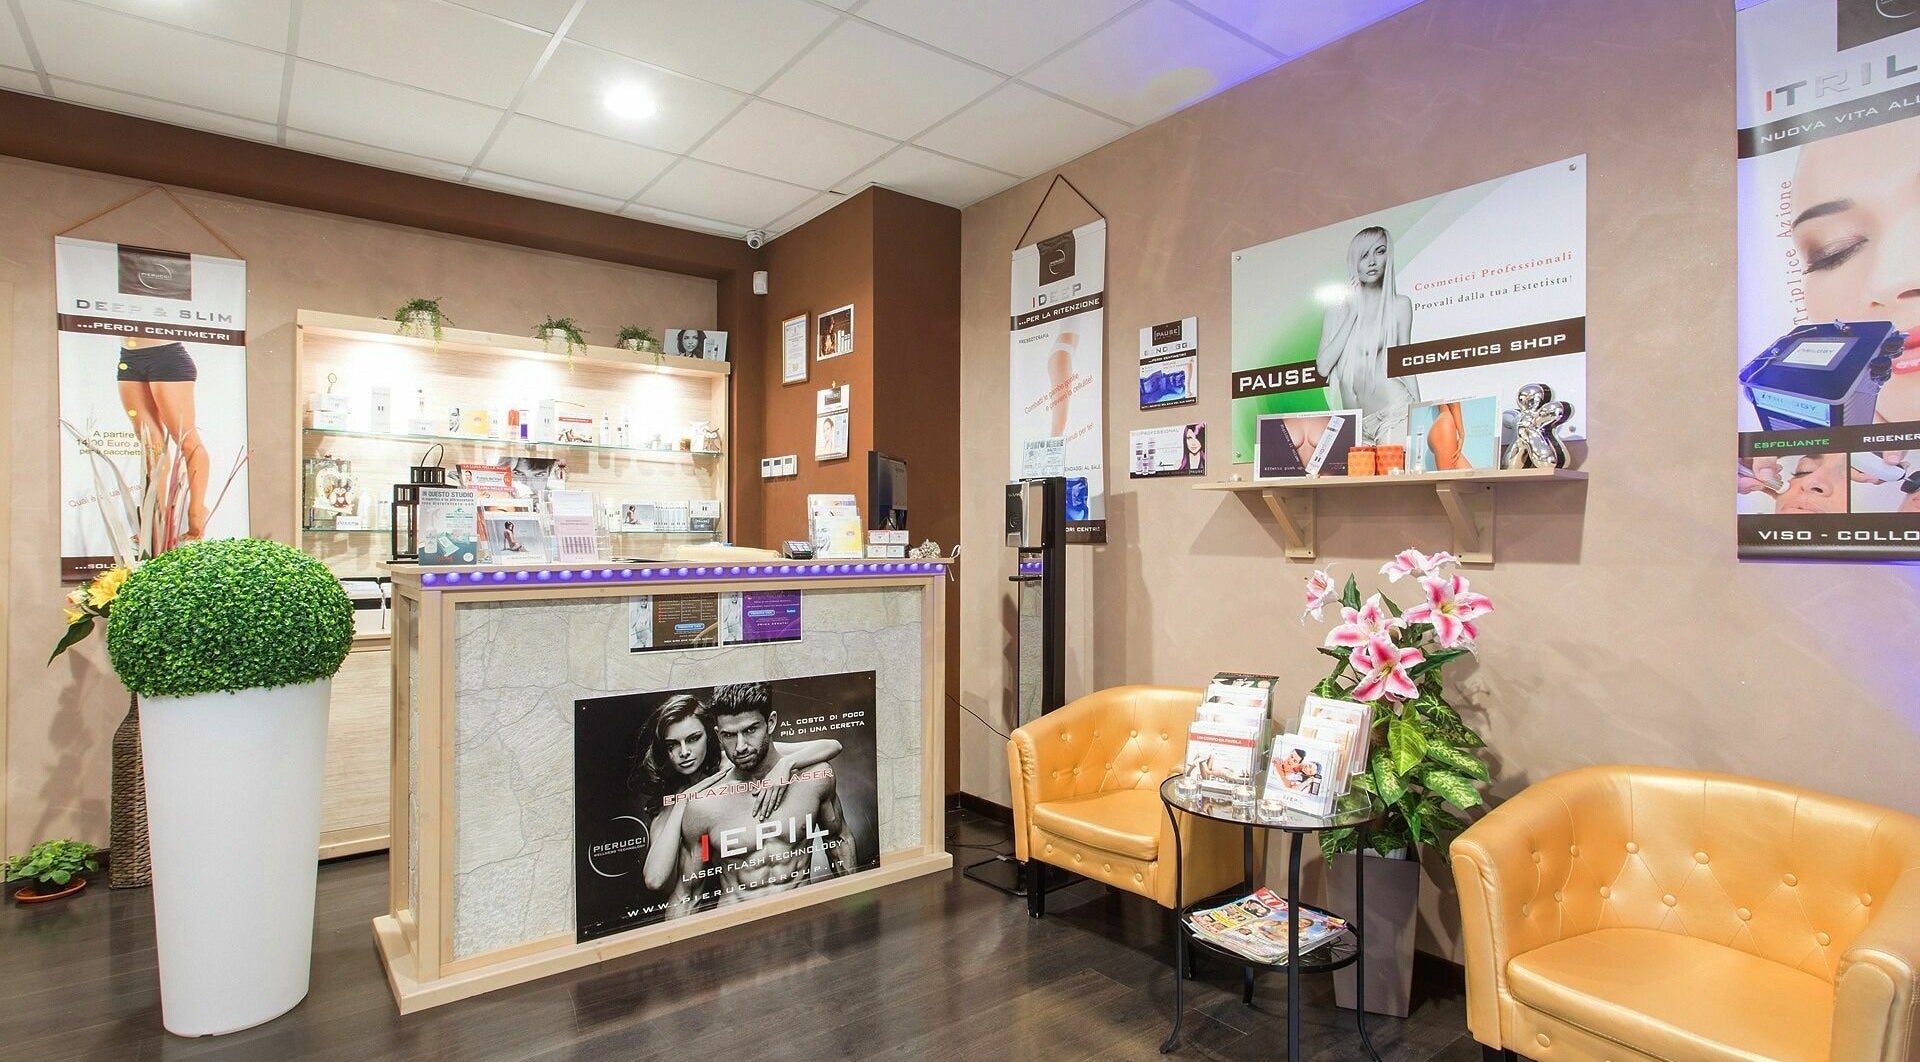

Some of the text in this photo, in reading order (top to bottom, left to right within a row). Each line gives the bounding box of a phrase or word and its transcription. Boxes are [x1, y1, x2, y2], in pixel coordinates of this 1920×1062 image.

[1760, 120, 1824, 144] NUOVA
[1835, 107, 1879, 124] VITA
[1776, 180, 1792, 238] Azione
[1414, 251, 1572, 292] Cosmetici Professionali
[1414, 275, 1572, 311] Provali dalla tua Estetista!
[1786, 248, 1808, 325] Triplice
[76, 299, 141, 313] DEEP
[179, 310, 232, 323] SLIM
[1054, 298, 1100, 316] RITENZIONE
[144, 326, 230, 340] CENTIMETRI
[1402, 334, 1566, 367] COSMETICS SHOP
[1240, 367, 1316, 392] PAUSE
[1754, 439, 1830, 449] ESFOLIANTE
[1758, 531, 1812, 541] VISO
[1837, 530, 1920, 541] COLLO
[780, 728, 794, 737] PIÙ
[830, 721, 865, 729] CERETTA
[796, 716, 825, 724] COSTO
[662, 768, 834, 808] EPILAZIONE LASER
[593, 836, 646, 853] PIERUCCI
[682, 840, 844, 882] LASER FLASH TECHNOLOGY
[627, 860, 844, 918] WWW.PIERUCCIGROUP.IT
